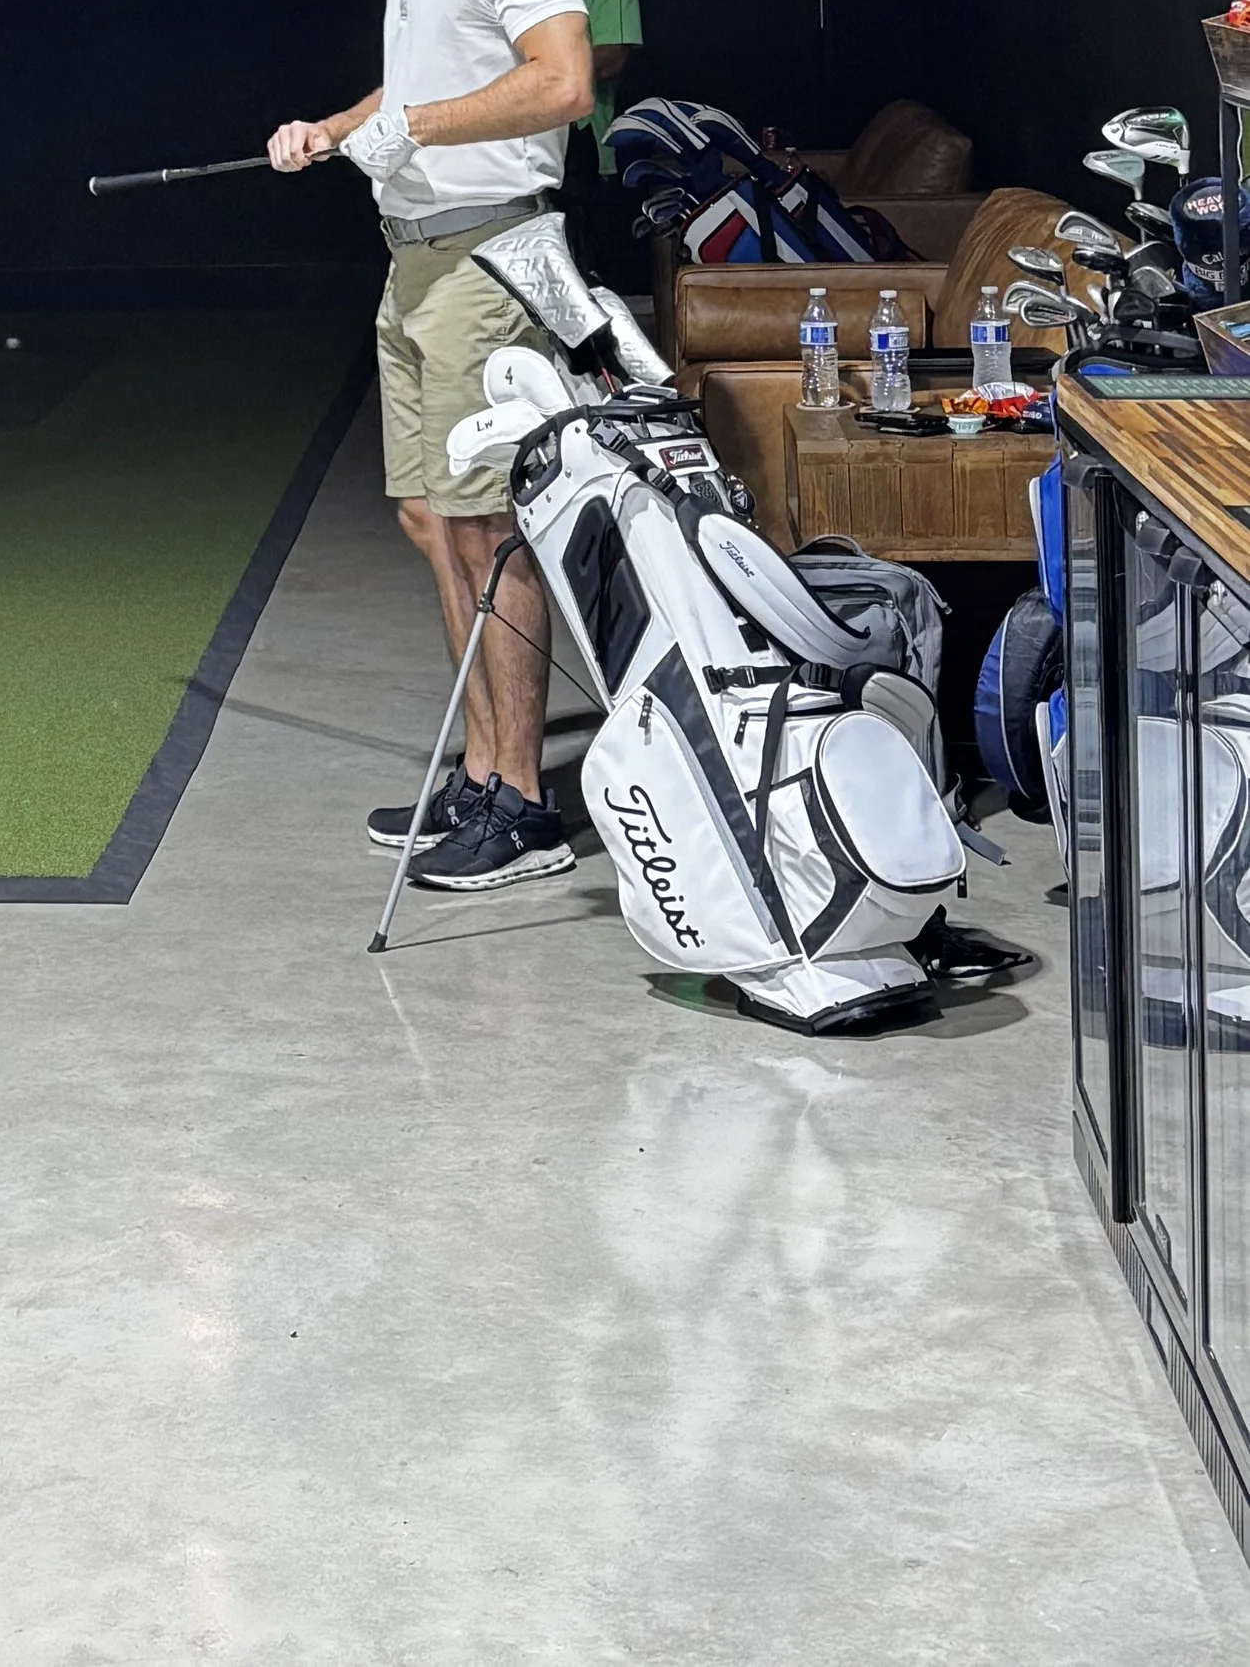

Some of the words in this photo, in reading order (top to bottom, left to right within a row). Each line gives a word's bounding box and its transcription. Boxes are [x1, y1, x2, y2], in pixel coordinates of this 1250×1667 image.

[1187, 194, 1222, 210] HEAV
[504, 366, 513, 385] 4
[719, 540, 755, 578] Titleist
[604, 784, 706, 949] Titleist
